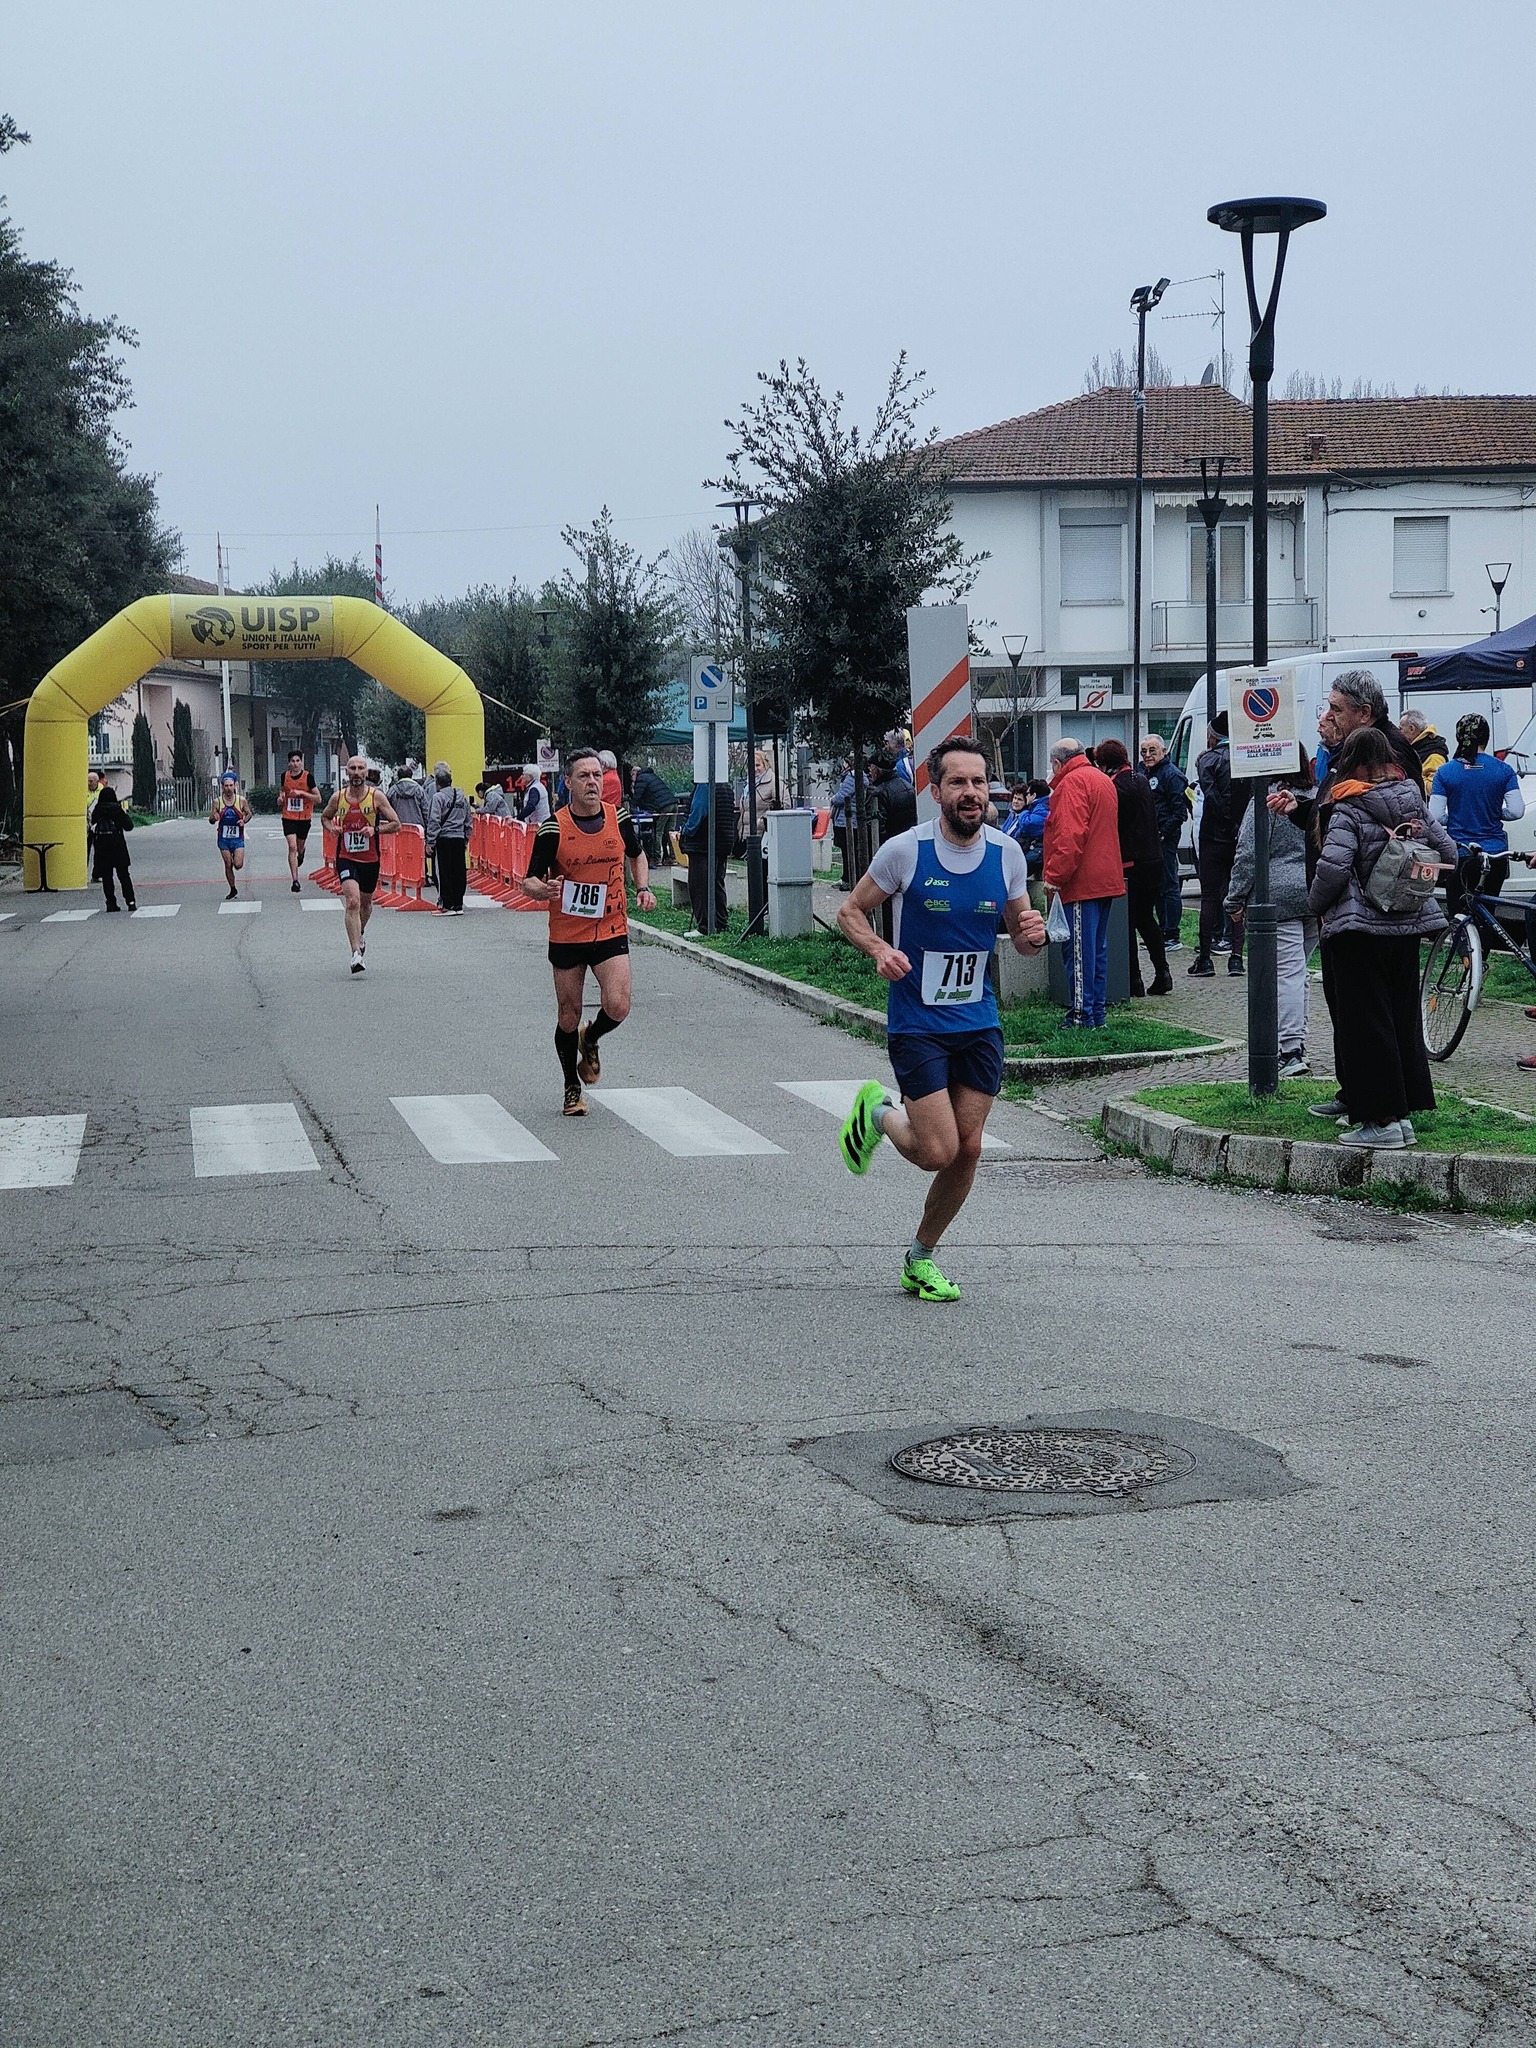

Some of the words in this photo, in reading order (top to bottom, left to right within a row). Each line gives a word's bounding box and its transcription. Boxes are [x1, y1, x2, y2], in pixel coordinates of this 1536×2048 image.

[241, 606, 320, 632] UISP
[242, 633, 276, 643] UNIONE
[281, 633, 321, 642] ITALIANA
[242, 642, 270, 650] SPORT
[274, 642, 289, 650] PER
[293, 642, 316, 650] TUTTI
[696, 698, 705, 709] P
[348, 832, 366, 846] 762
[932, 879, 950, 887] asics
[572, 883, 600, 906] 786
[940, 953, 978, 987] 713
